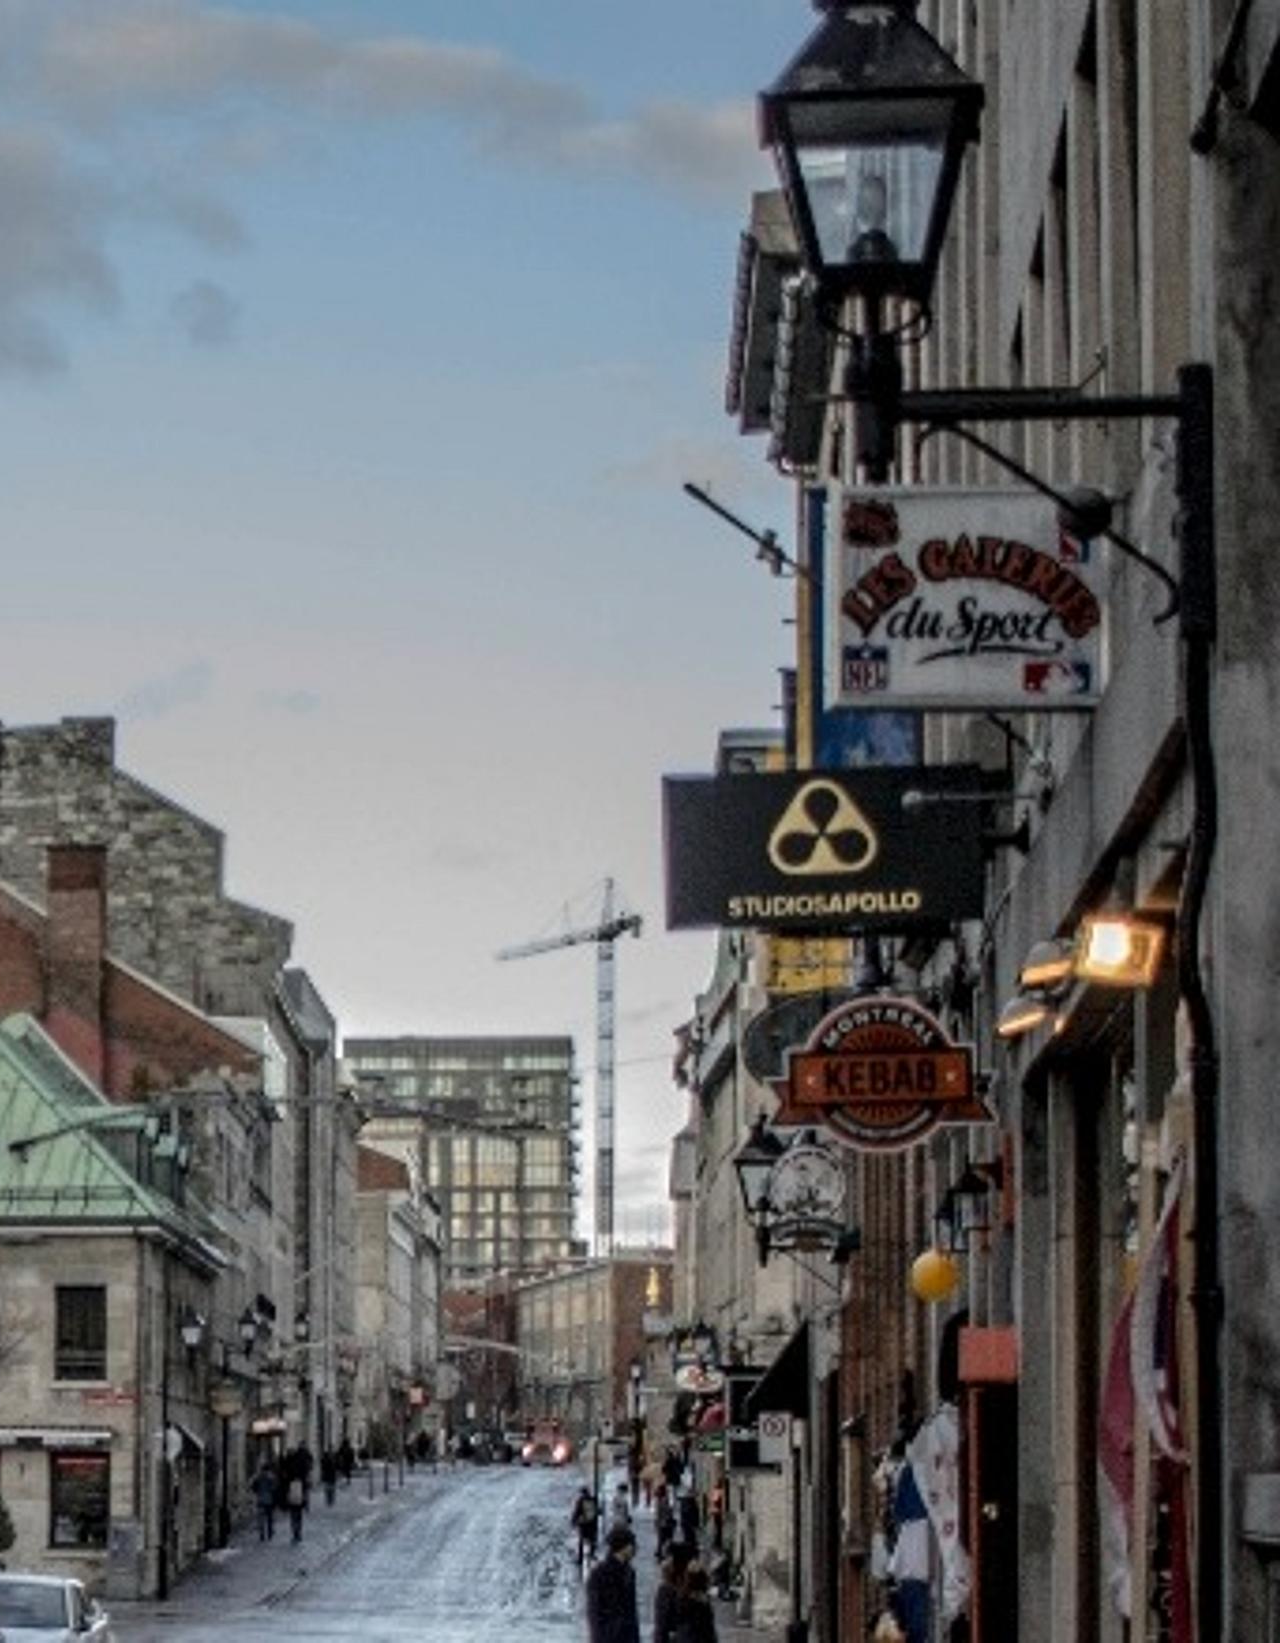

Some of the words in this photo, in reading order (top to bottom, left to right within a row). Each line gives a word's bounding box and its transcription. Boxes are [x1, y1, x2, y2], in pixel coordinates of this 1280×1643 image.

[842, 552, 918, 638] LES
[918, 533, 1101, 639] GALERIES
[886, 597, 941, 640] du
[946, 596, 1056, 657] Sport
[847, 661, 887, 692] NFL
[823, 1058, 937, 1096] KEBAB
